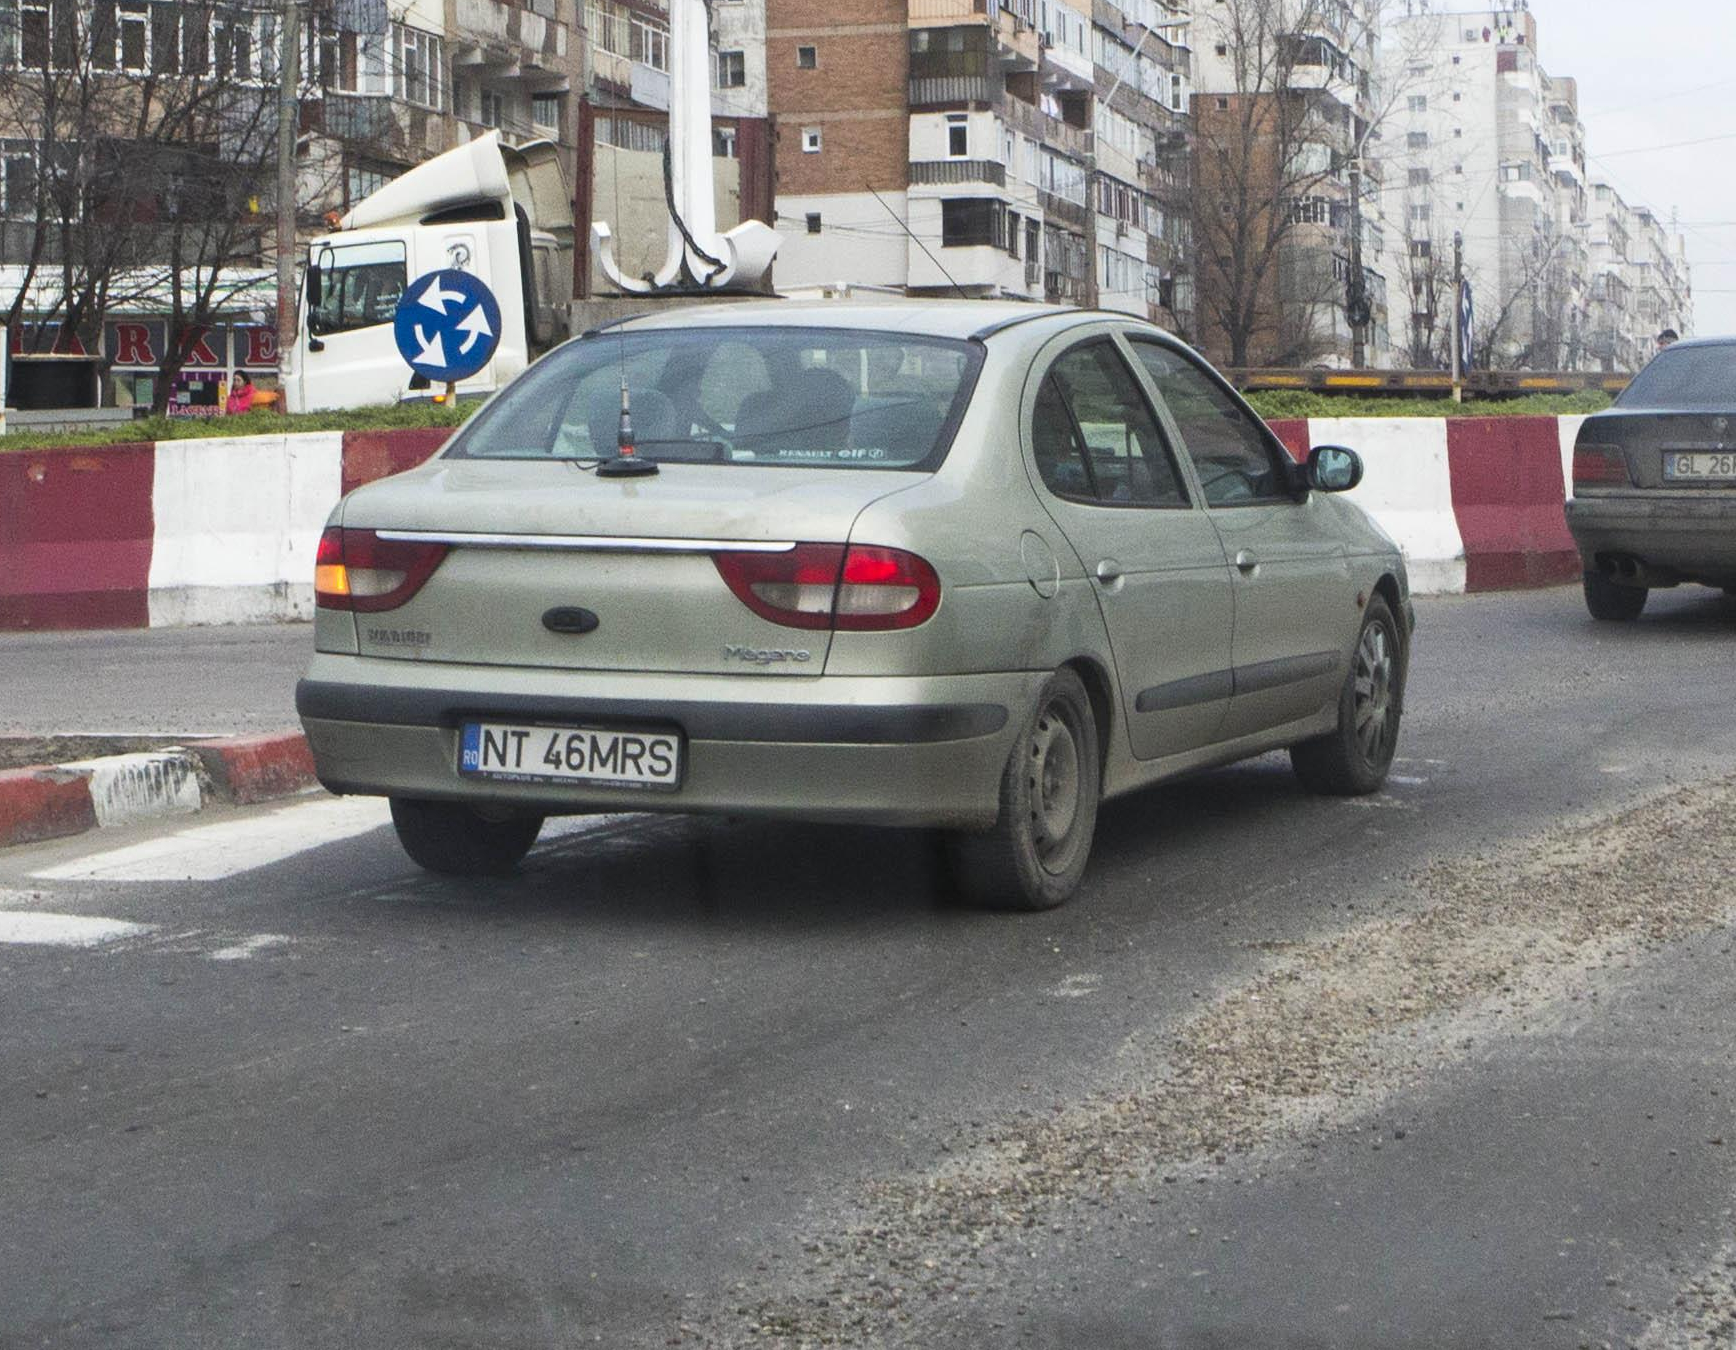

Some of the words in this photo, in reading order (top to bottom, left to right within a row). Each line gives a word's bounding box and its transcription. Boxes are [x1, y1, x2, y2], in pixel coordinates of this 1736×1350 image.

[1676, 455, 1701, 474] GL
[463, 751, 478, 766] RO
[482, 729, 530, 769] NT
[543, 732, 673, 778] 46MRS
